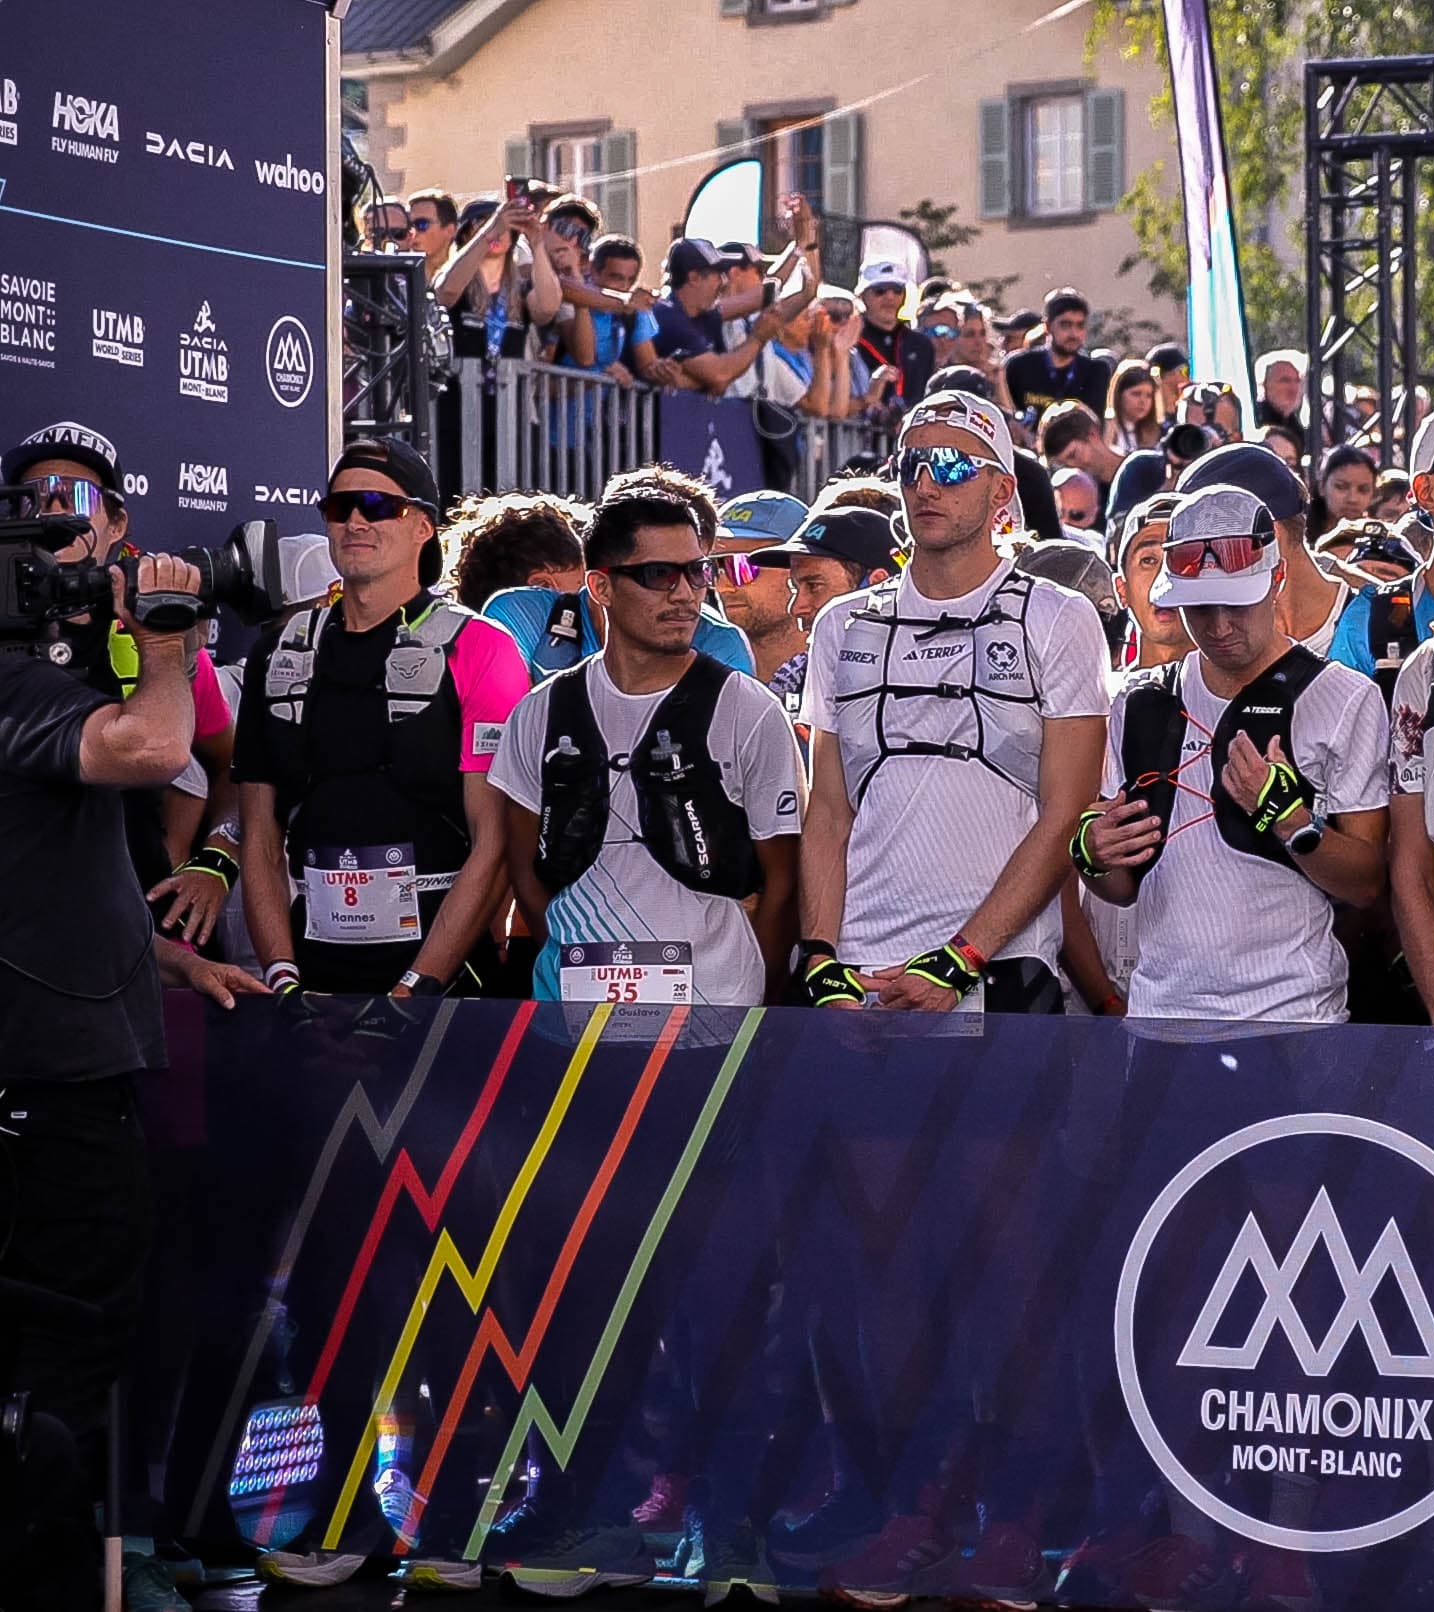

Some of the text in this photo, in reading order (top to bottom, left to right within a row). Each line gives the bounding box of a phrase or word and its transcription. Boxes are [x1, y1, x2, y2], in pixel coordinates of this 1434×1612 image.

[52, 91, 120, 142] HOKA
[52, 136, 119, 164] FLY HUMAN FLY
[145, 131, 235, 171] DACIA
[254, 153, 325, 195] wahoo
[1, 274, 56, 302] SAVOIE
[0, 325, 55, 351] BLANC
[92, 308, 144, 345] UTMB
[94, 343, 143, 363] WORLD SERIES
[179, 333, 228, 352] DACIA
[179, 351, 229, 382] UTMB
[178, 462, 228, 495] HOKA
[920, 643, 967, 660] TERREX
[684, 799, 710, 866] SCARPA
[326, 872, 371, 885] UTMB
[344, 886, 358, 907] 8
[331, 911, 376, 922] Hannes
[597, 967, 643, 981] UTMB
[606, 982, 638, 1004] 55
[618, 1008, 661, 1017] Gustavo
[1200, 1388, 1433, 1442] CHAMONIX
[1231, 1444, 1403, 1479] MONT-BLANC
